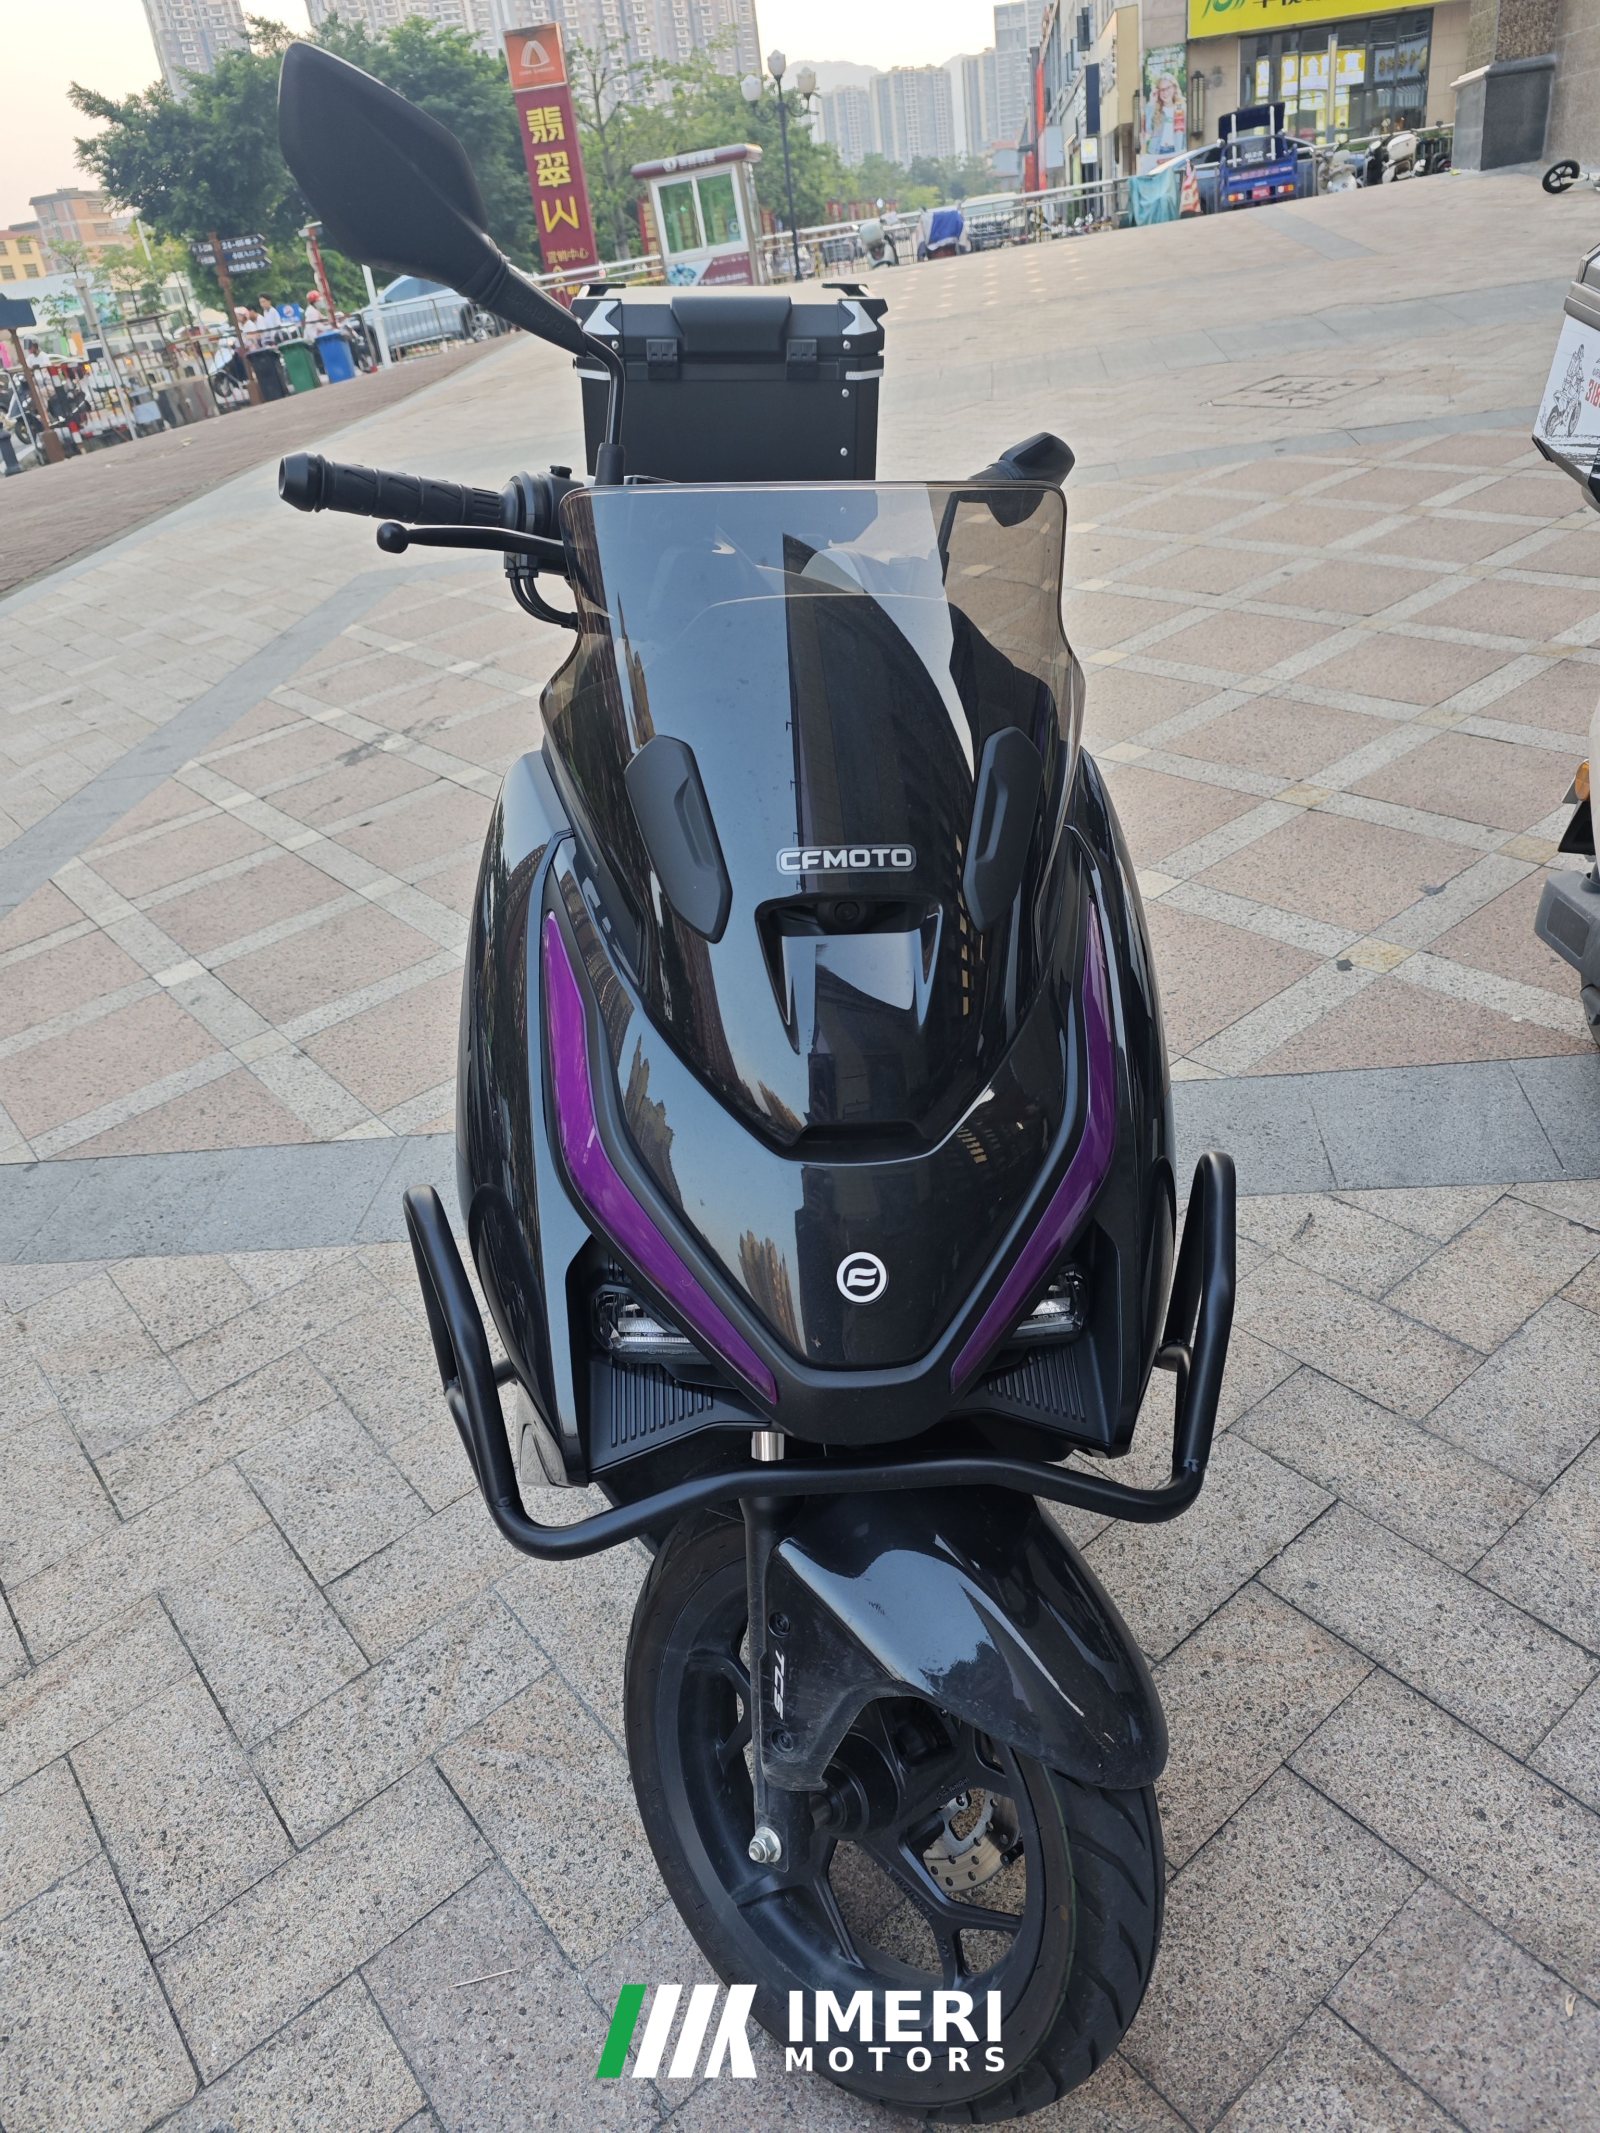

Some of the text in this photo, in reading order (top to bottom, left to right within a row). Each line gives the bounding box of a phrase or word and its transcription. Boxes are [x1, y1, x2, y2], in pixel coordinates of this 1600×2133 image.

[1585, 378, 1600, 408] 318
[780, 848, 912, 871] CFMOTO
[773, 1650, 785, 1720] TCS
